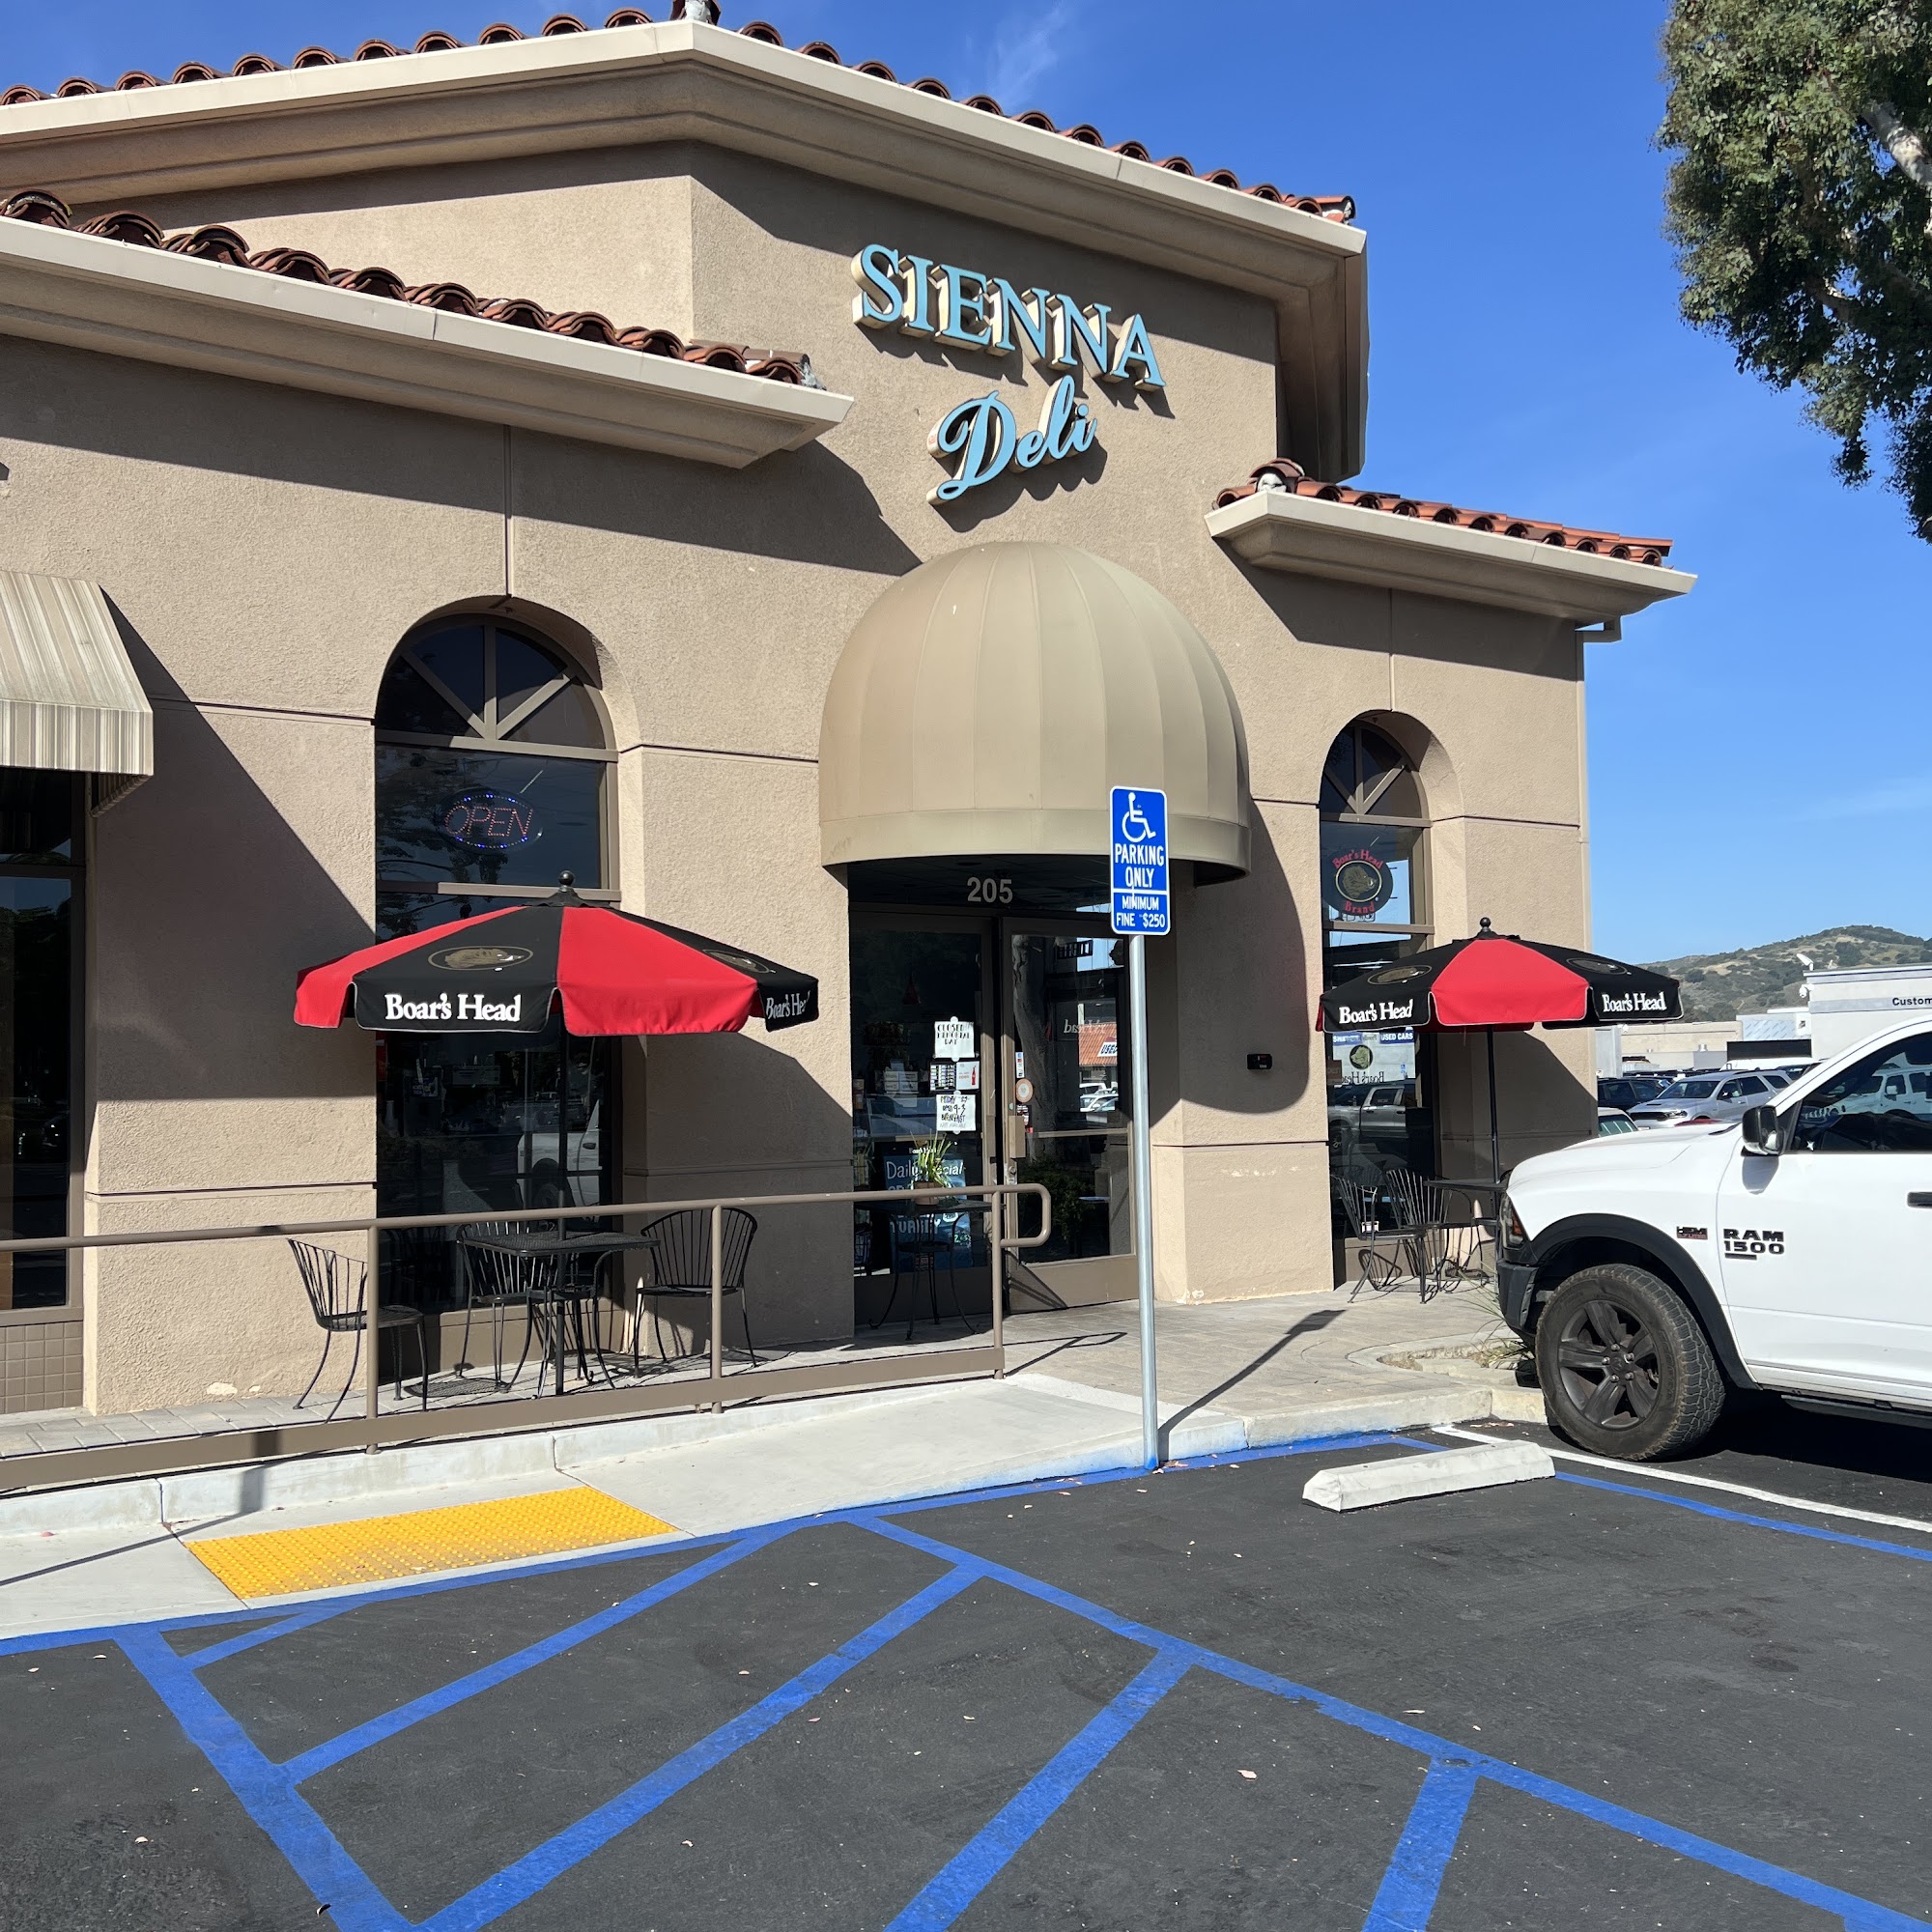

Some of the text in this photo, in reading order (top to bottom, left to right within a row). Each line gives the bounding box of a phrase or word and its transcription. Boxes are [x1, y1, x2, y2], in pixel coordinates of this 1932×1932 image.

[854, 243, 1165, 389] SIENNA
[932, 375, 1097, 502] Deli
[442, 804, 533, 838] OPEN
[1114, 842, 1164, 867] PARKING
[1332, 849, 1384, 869] Boar's Head
[1124, 867, 1154, 888] ONLY
[966, 876, 1013, 903] 205
[1122, 895, 1159, 911] MINIMUM
[1344, 899, 1376, 914] Brand
[1116, 912, 1166, 928] FINE $250
[384, 992, 522, 1022] Boar's Head
[766, 993, 791, 1020] Boar's
[1339, 999, 1413, 1024] Boar's Head
[1601, 991, 1667, 1012] Boar's Head
[1892, 997, 1932, 1007] Custom
[1398, 1032, 1414, 1040] CARS
[1723, 1228, 1784, 1242] RAM
[1723, 1240, 1785, 1255] 1500
